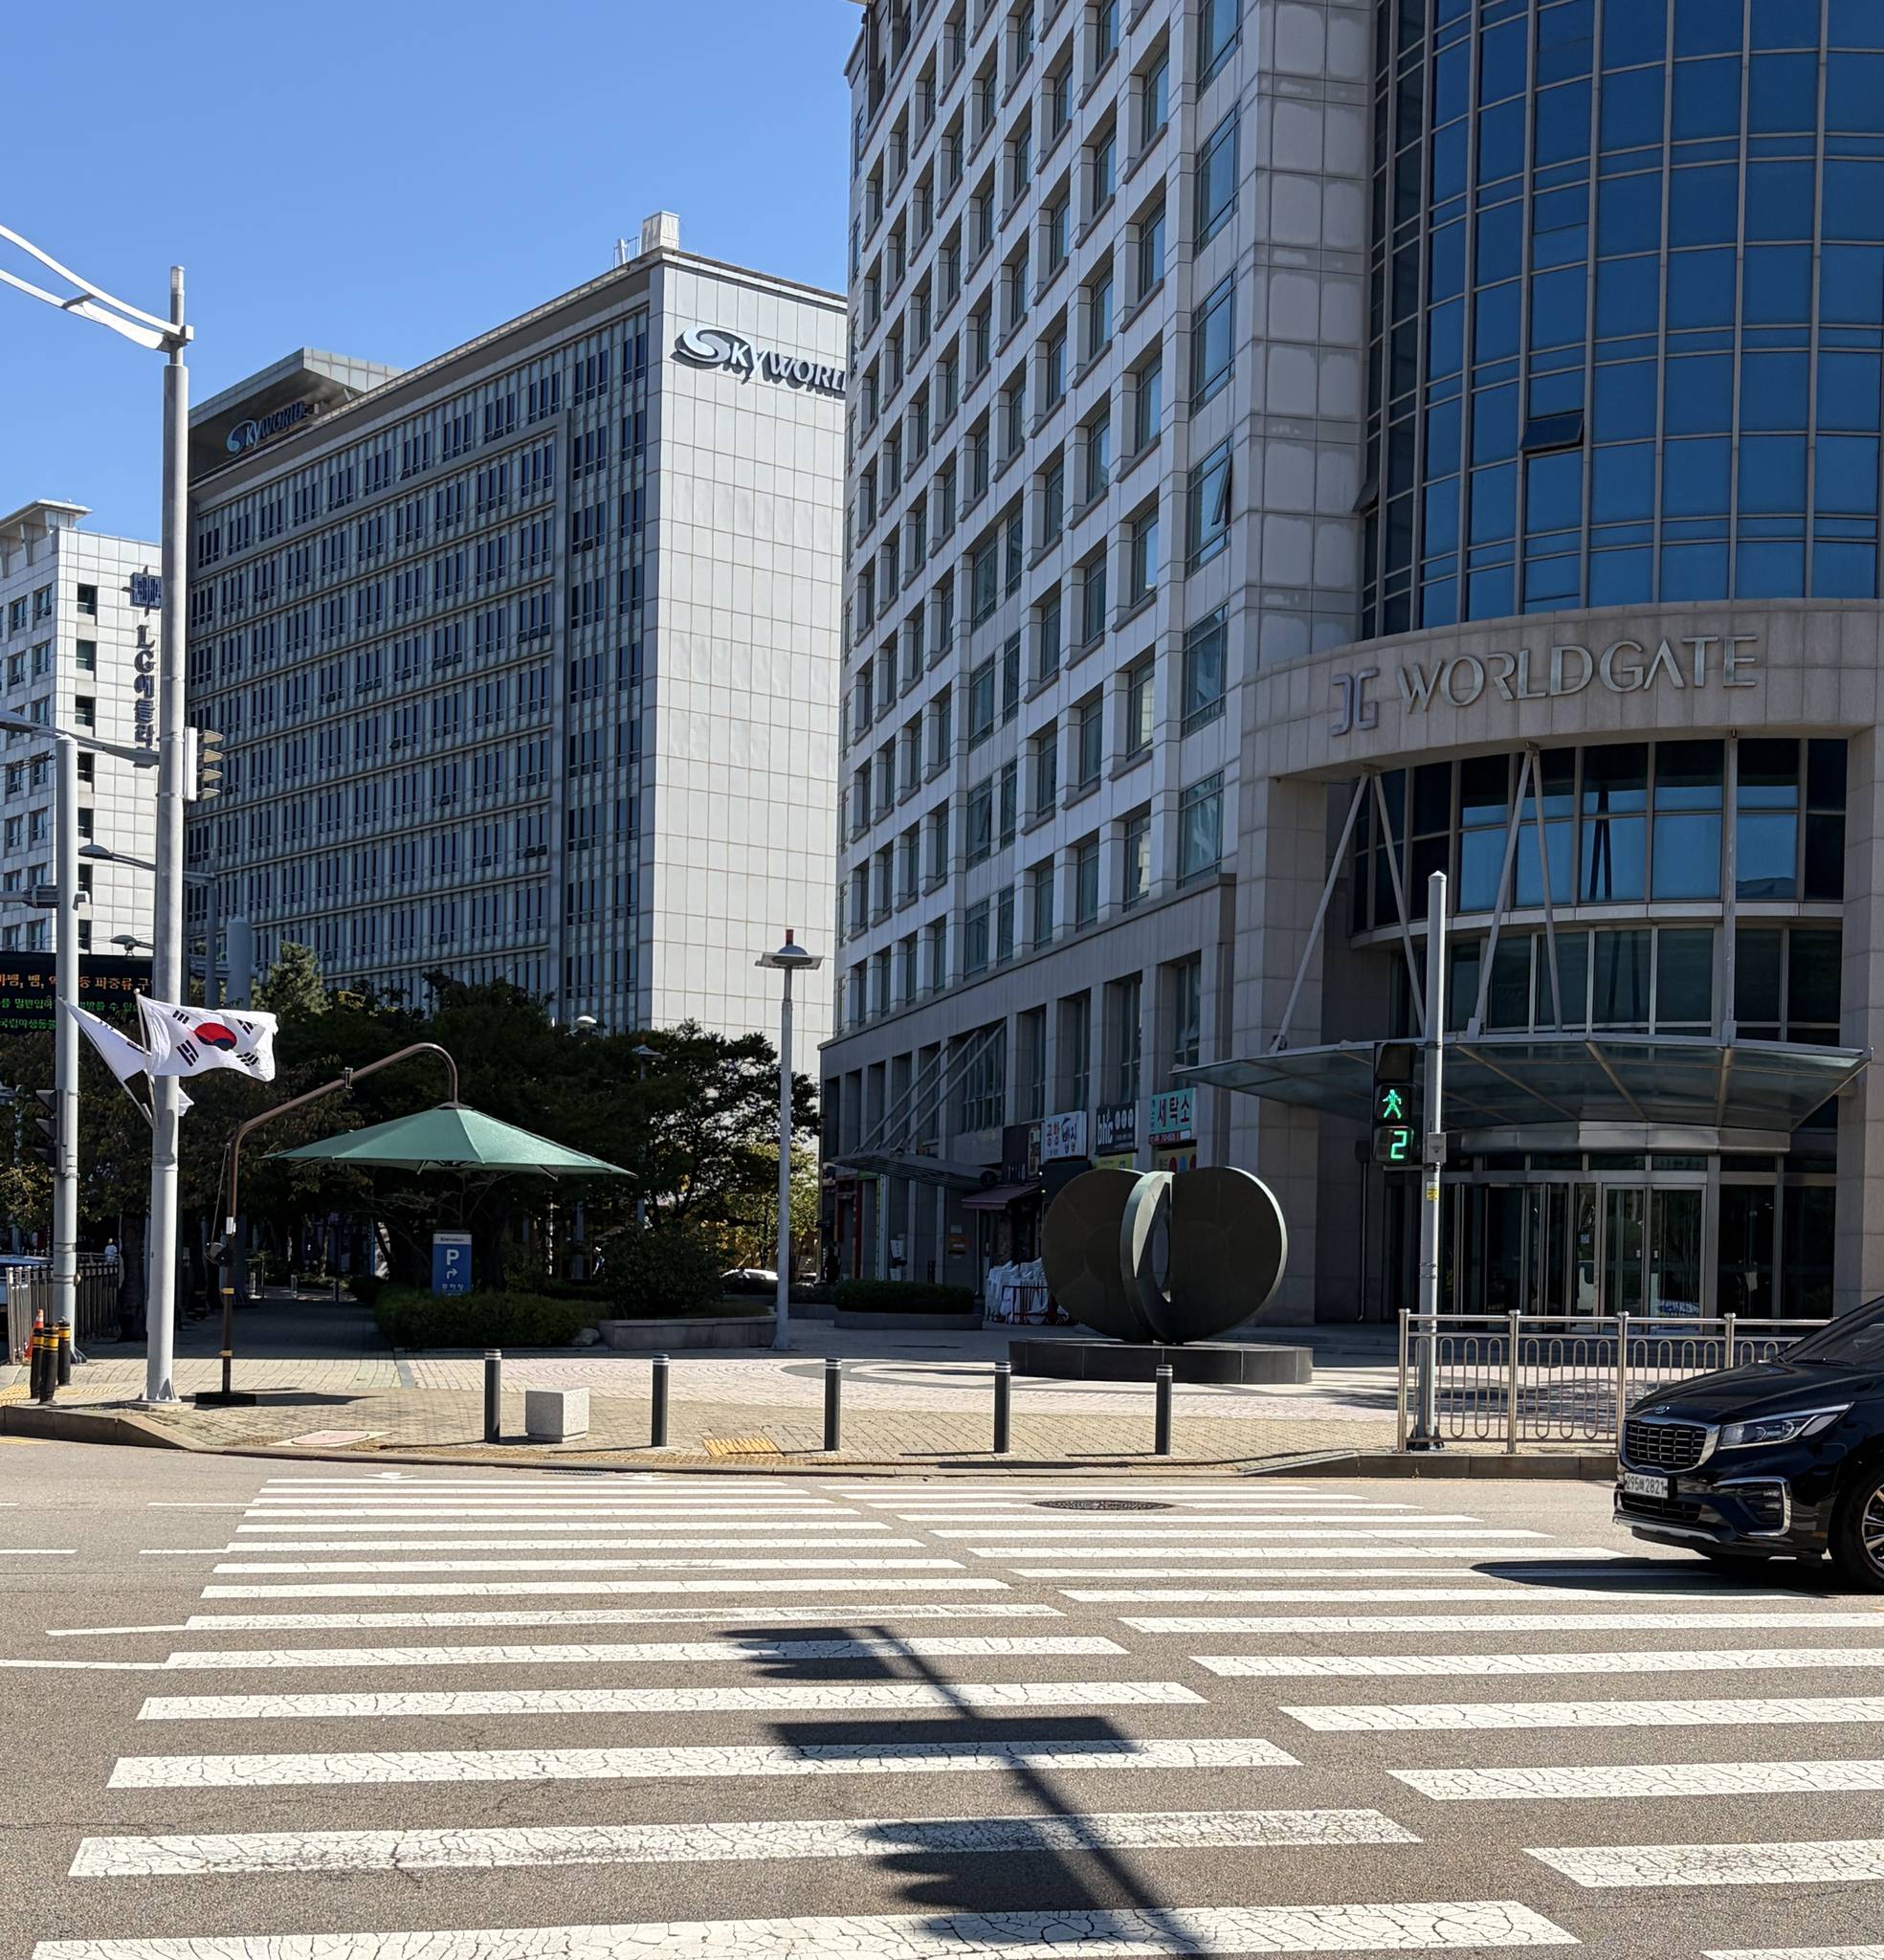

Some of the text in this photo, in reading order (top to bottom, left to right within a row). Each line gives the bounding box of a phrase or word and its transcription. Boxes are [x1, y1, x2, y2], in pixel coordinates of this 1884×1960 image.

[674, 326, 847, 392] SKYWORL
[1396, 635, 1758, 714] WORLDGATE
[134, 625, 155, 769] LG에클라
[14, 997, 54, 1010] 밀반입하
[1158, 1094, 1189, 1127] 세탁소
[1097, 1113, 1113, 1146] bhc
[1390, 1130, 1407, 1159] 2
[446, 1249, 459, 1265] P
